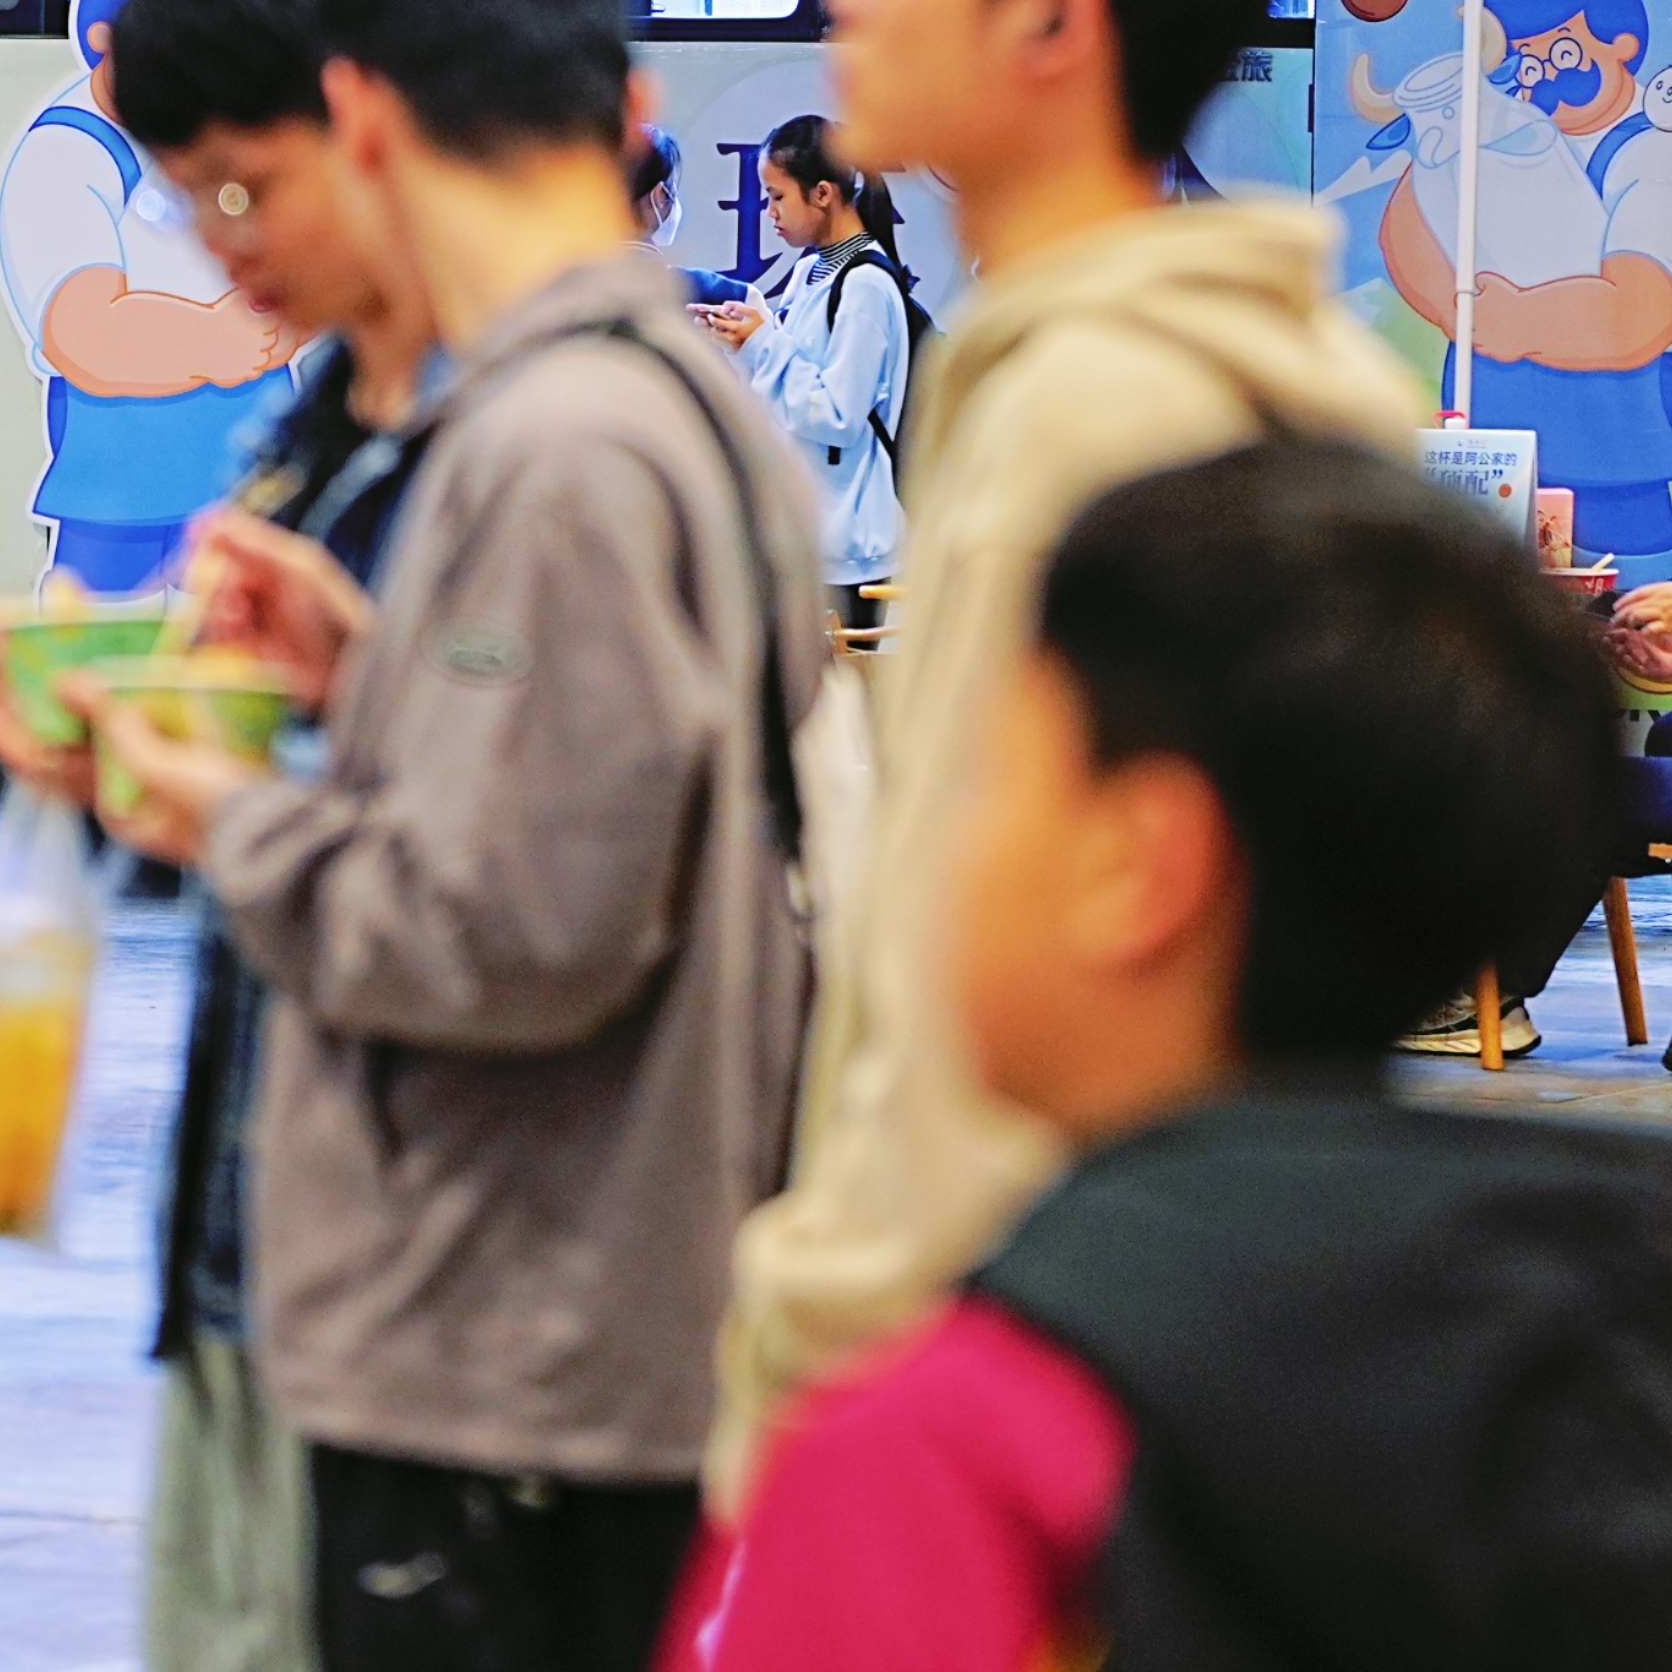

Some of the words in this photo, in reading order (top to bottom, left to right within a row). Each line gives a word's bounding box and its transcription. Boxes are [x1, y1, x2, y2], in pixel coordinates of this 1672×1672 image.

[1424, 450, 1518, 467] 这杯是阿公家的
